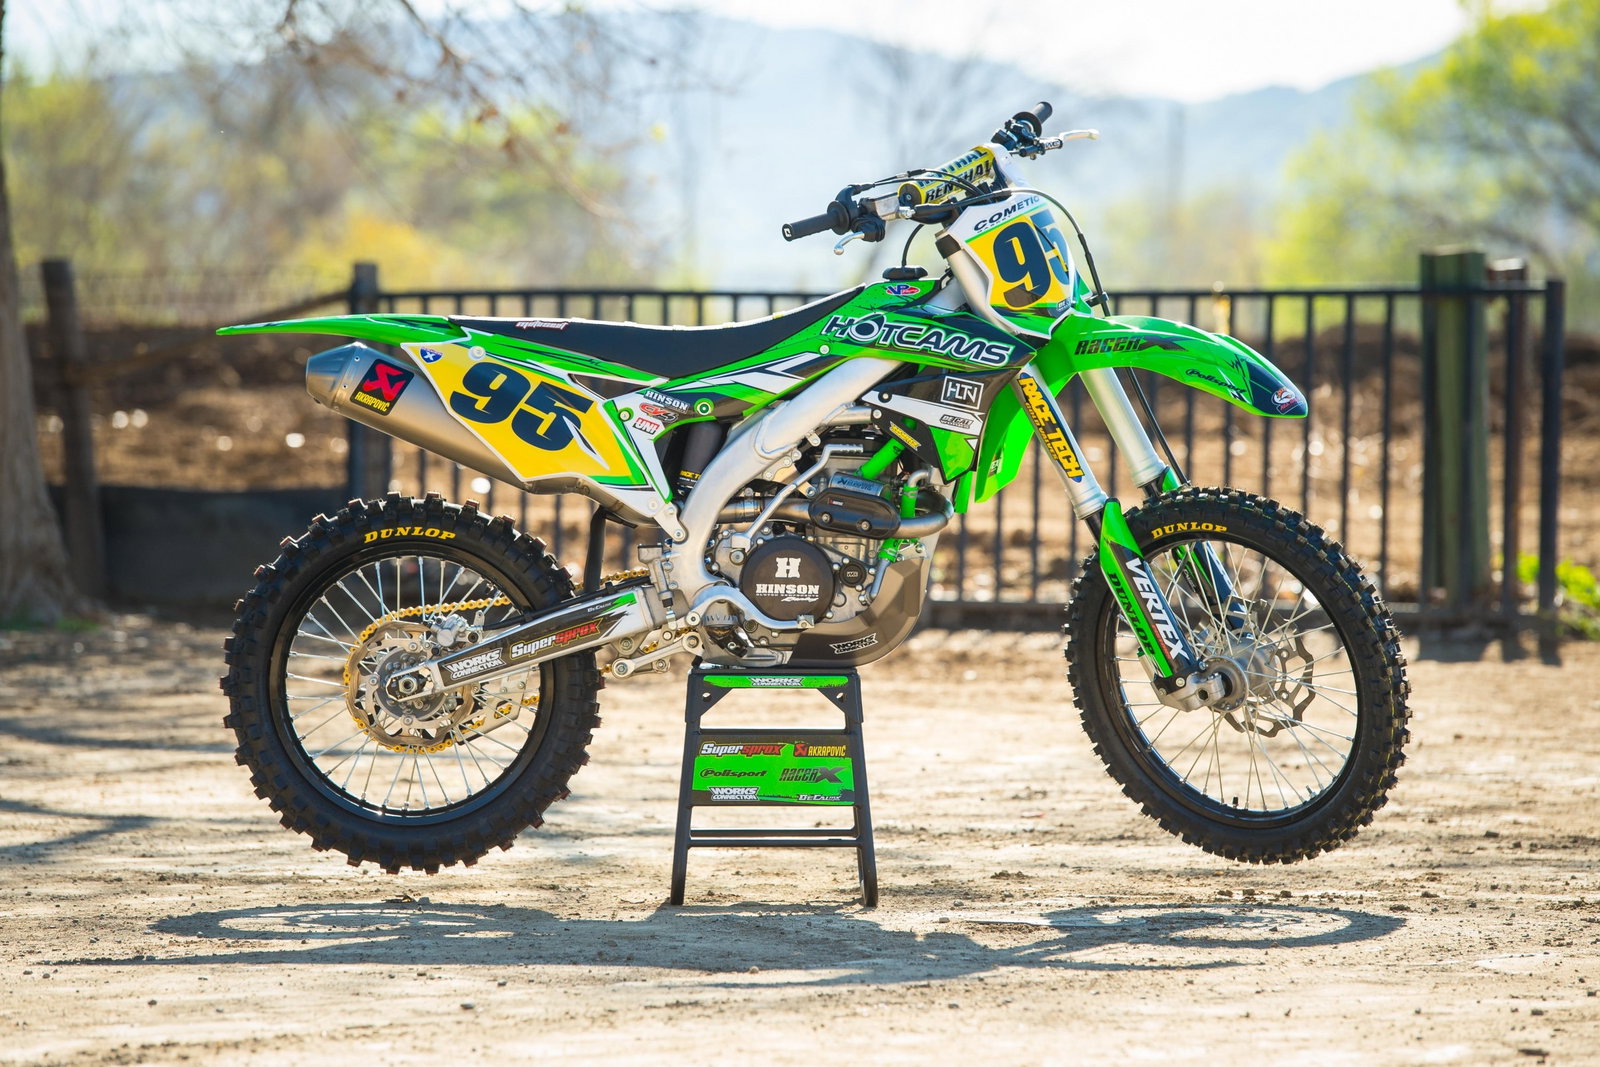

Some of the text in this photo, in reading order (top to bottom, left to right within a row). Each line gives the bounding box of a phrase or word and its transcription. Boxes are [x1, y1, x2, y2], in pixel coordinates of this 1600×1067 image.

[974, 196, 1039, 231] COMETIC
[993, 209, 1071, 307] 95
[821, 312, 1014, 366] HOTCAMS
[449, 361, 595, 451] 95
[645, 390, 688, 411] HINSON
[634, 418, 658, 434] UNI
[1018, 377, 1085, 478] RACE TECH
[364, 526, 456, 544] DUNLOP
[1151, 521, 1228, 539] DUNLOP
[756, 584, 819, 594] HINSON
[1109, 572, 1155, 655] DUNLOP
[1125, 557, 1190, 660] VERTEX
[832, 635, 874, 648] WORKS
[447, 650, 500, 671] WORKS
[452, 659, 503, 678] CONNECTION
